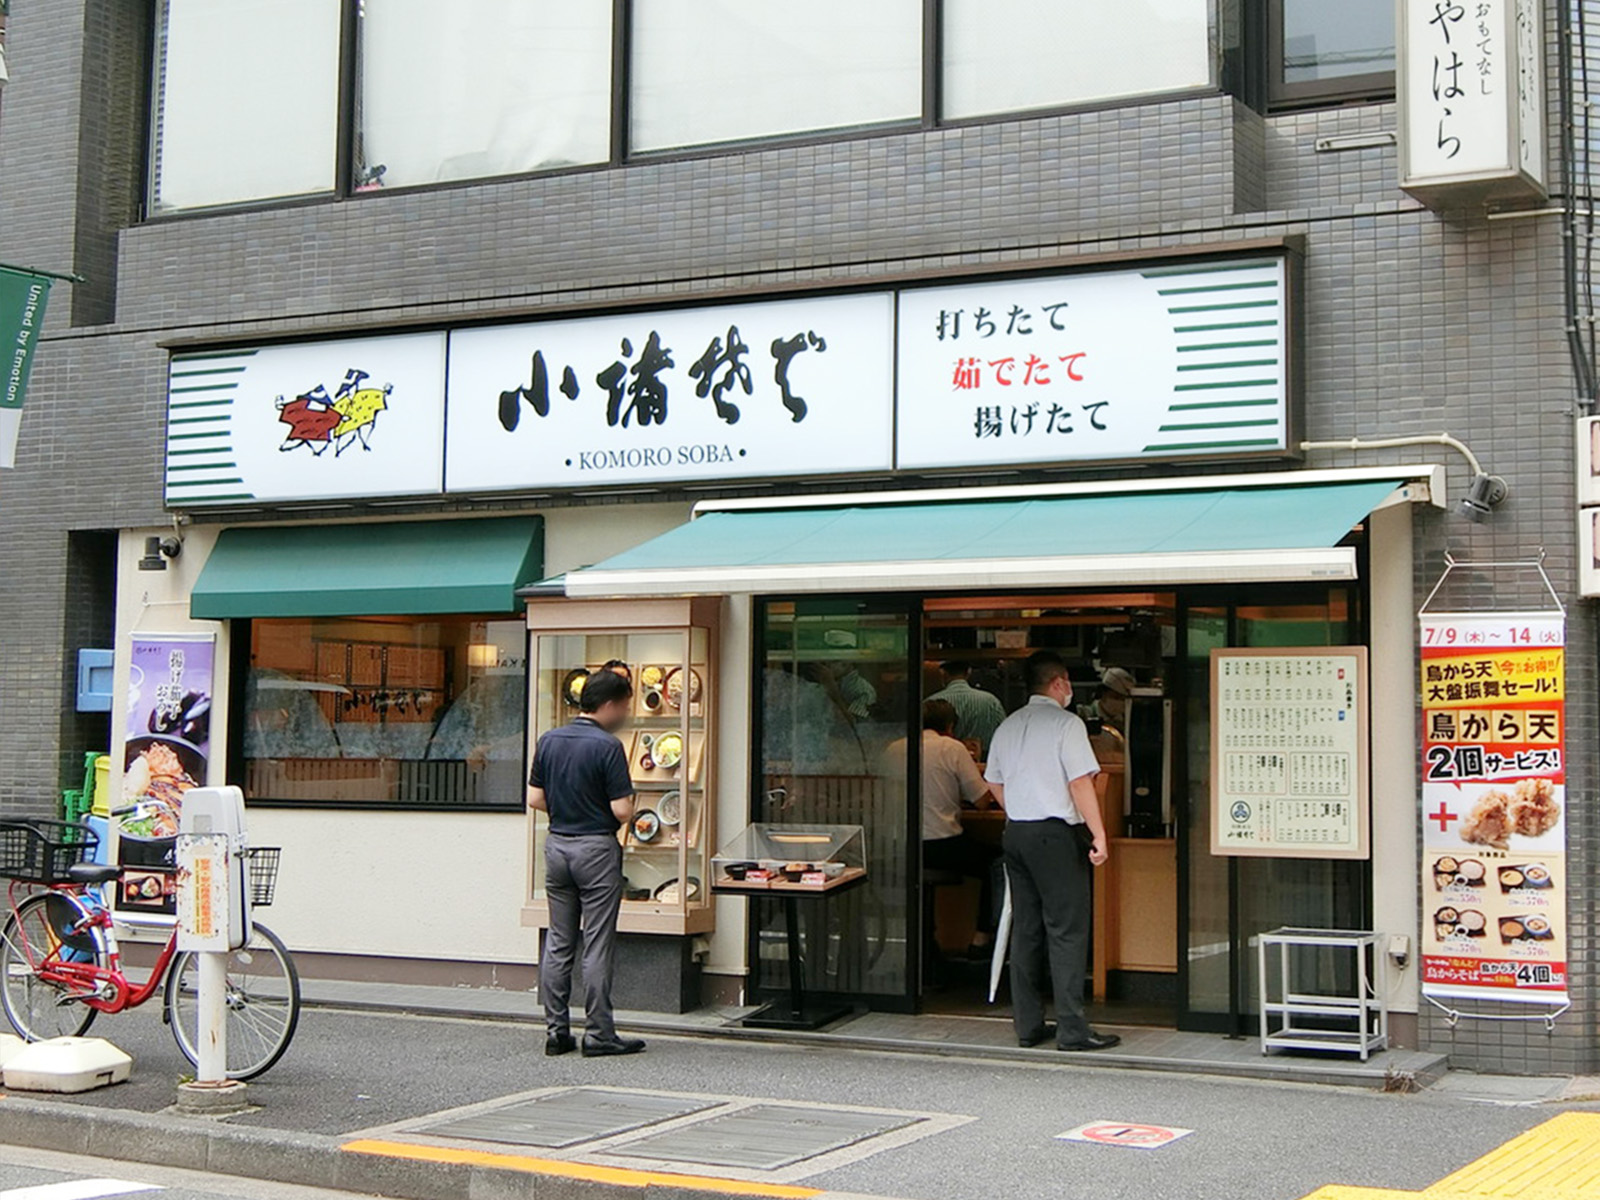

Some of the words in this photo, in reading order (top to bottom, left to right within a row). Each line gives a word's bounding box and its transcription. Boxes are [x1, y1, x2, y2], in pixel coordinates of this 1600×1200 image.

[1475, 3, 1493, 95] おもてなし
[1429, 0, 1465, 159] やはら
[22, 284, 42, 327] United
[936, 302, 1069, 341] 打ちたて
[17, 331, 30, 346] by
[7, 350, 27, 402] Emotion
[952, 352, 1087, 391] 茹でたて
[974, 401, 1109, 438] 揚げたて
[579, 447, 672, 470] KOMORO
[677, 444, 734, 465] SOBA
[1426, 660, 1492, 682] 鳥から天
[1430, 713, 1556, 740] 鳥から天
[1428, 747, 1559, 779] 2個サービス!
